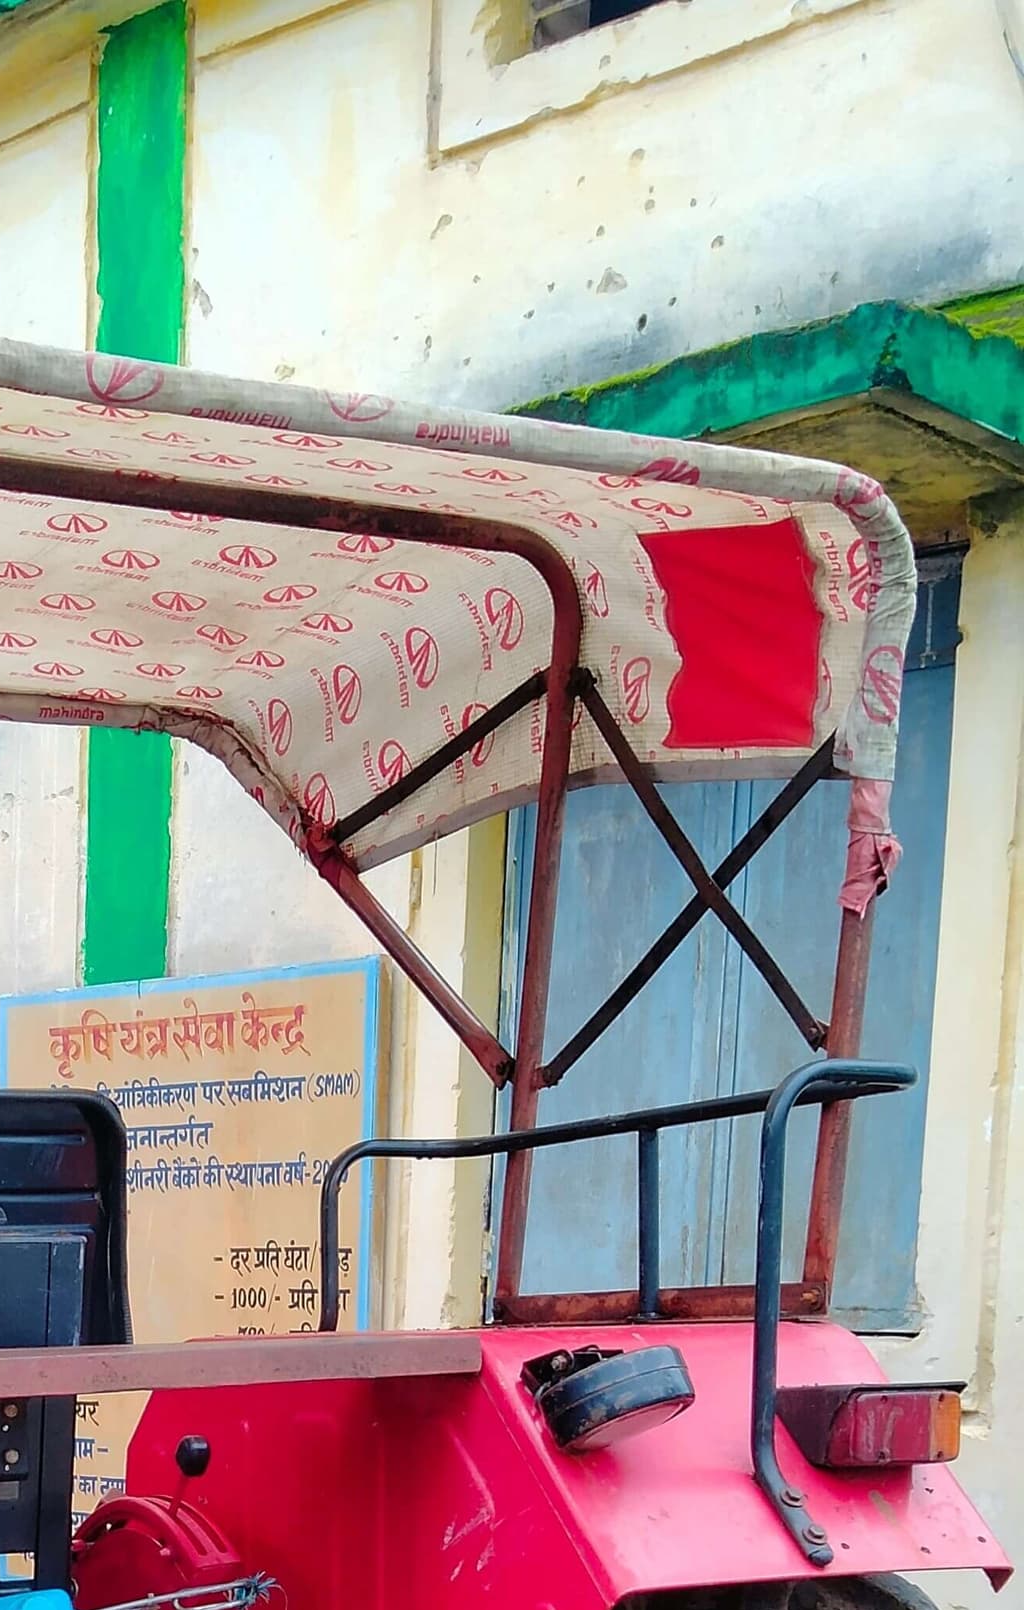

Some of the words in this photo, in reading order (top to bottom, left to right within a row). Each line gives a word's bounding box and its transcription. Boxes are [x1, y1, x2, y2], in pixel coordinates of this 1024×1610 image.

[414, 421, 512, 448] mahindra
[39, 705, 105, 721] mahindra
[49, 1008, 116, 1079] कृषि
[120, 1010, 169, 1060] यंत्र
[173, 997, 235, 1061] सेवा
[241, 991, 312, 1056] केन्द्र
[201, 1081, 226, 1106] पर
[307, 1069, 361, 1103] (SMAM)
[126, 1115, 214, 1151] जनान्तर्गत
[127, 1159, 171, 1193] शीनरी
[203, 1156, 225, 1189] की
[225, 1161, 283, 1192] स्थापना
[230, 1247, 252, 1276] दर
[254, 1240, 282, 1276] प्रति
[288, 1279, 318, 1316] प्रति
